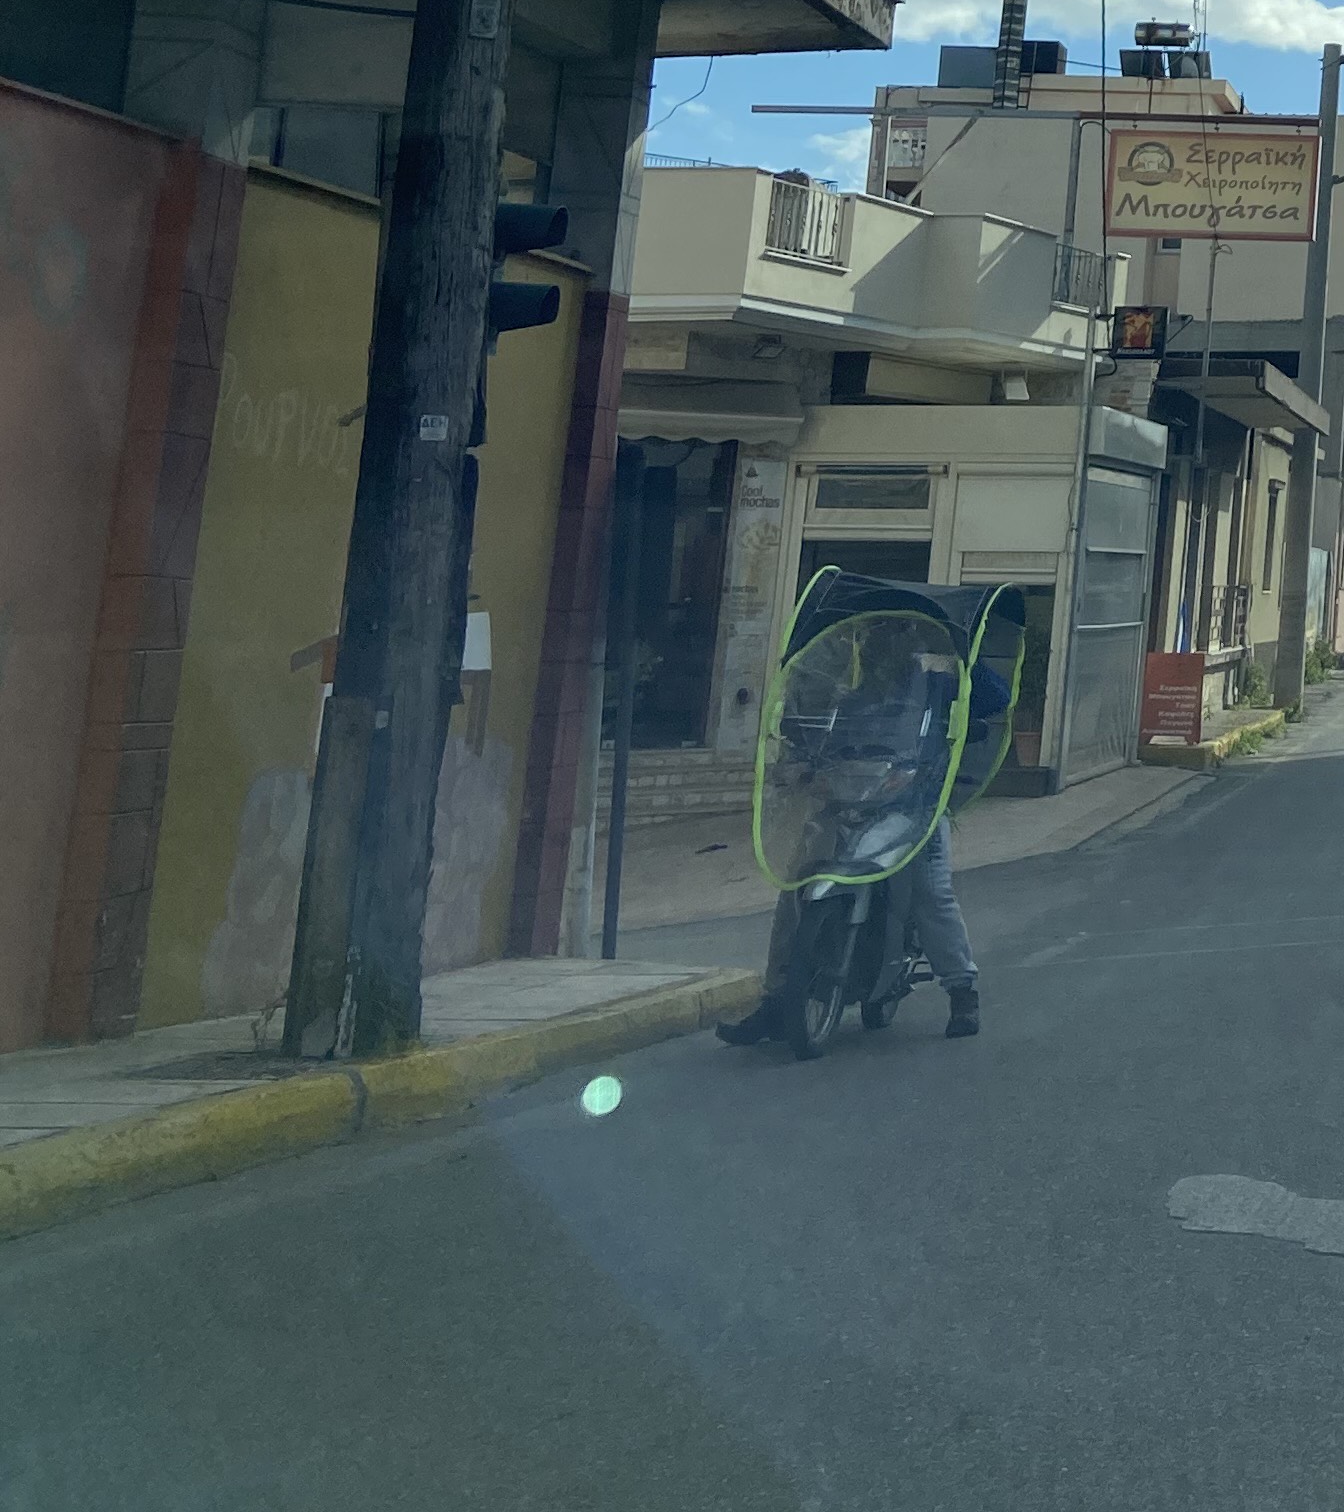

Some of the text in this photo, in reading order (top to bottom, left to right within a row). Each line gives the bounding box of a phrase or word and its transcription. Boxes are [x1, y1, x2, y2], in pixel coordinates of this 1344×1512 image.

[1186, 143, 1307, 175] Σερραϊκή
[1184, 170, 1303, 197] Χειροποίητη
[1115, 193, 1301, 228] Μπουγάτσα
[742, 485, 764, 497] Cool
